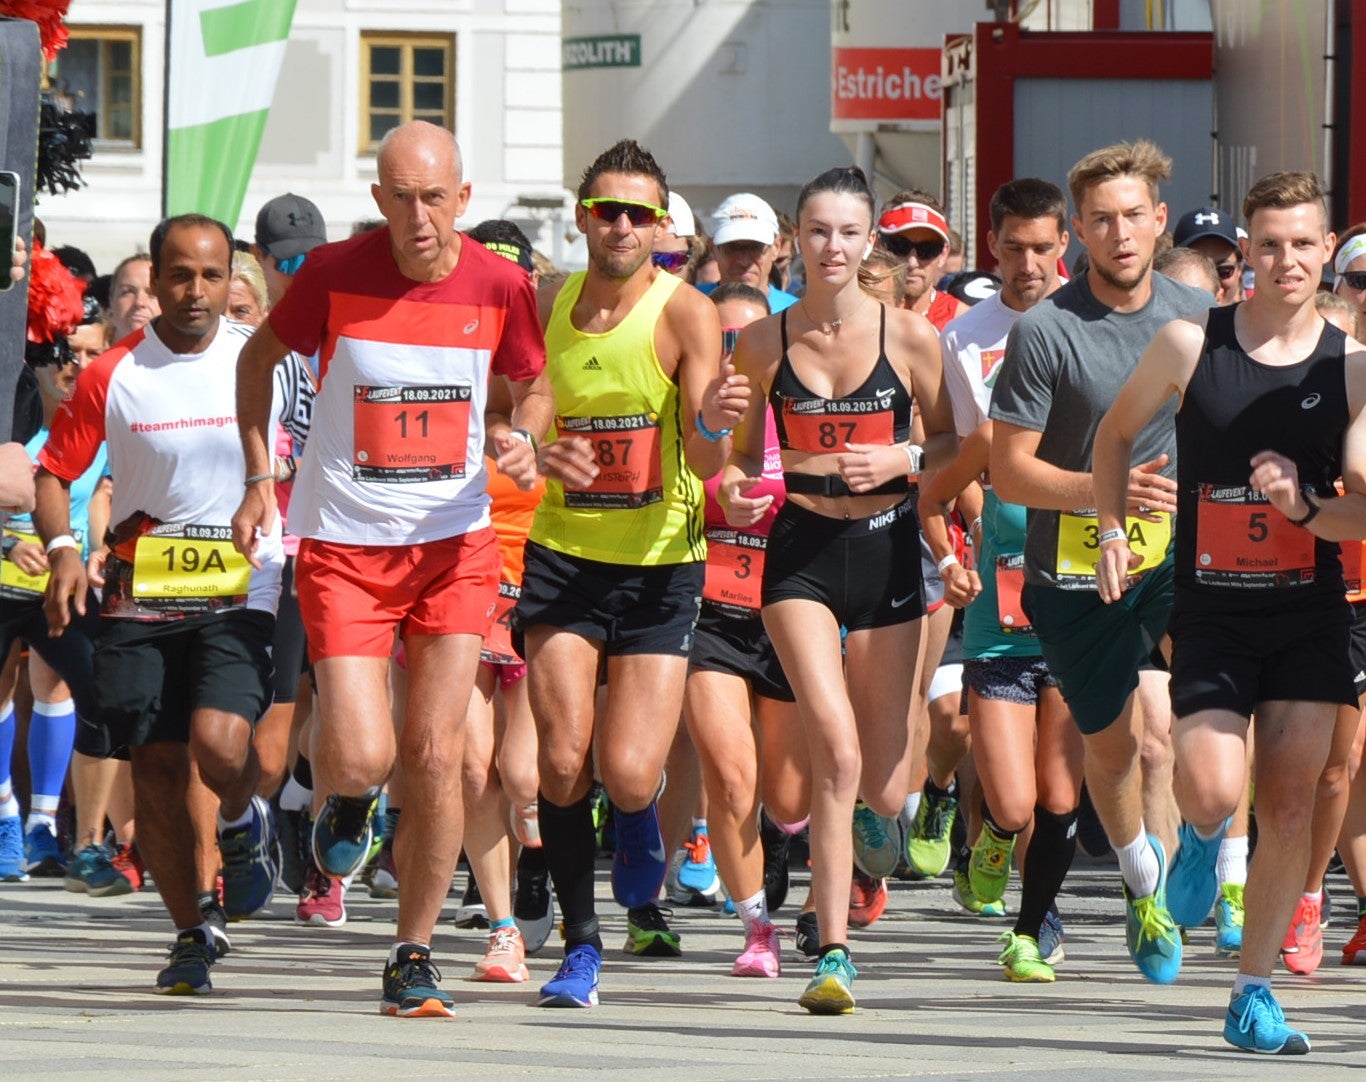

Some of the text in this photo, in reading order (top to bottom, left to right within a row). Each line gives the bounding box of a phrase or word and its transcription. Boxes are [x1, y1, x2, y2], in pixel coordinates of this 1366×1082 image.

[838, 66, 943, 99] Estriche
[403, 389, 457, 400] 18.09.2021
[826, 401, 879, 413] 18.09.2021
[394, 410, 429, 438] 11
[593, 418, 643, 430] 18.09.2021
[818, 421, 857, 449] 87
[386, 454, 437, 464] Wolfgang
[596, 439, 634, 467] 87
[868, 510, 898, 530] NIKE
[1248, 513, 1268, 542] 5
[186, 527, 233, 540] 18.09.202
[738, 535, 768, 549] 18.09.2
[1082, 522, 1147, 549] 3A
[162, 546, 227, 574] 19A
[734, 554, 752, 579] 3
[1236, 557, 1278, 567] Michael
[163, 584, 219, 594] Raghunath
[720, 589, 753, 603] Marlies
